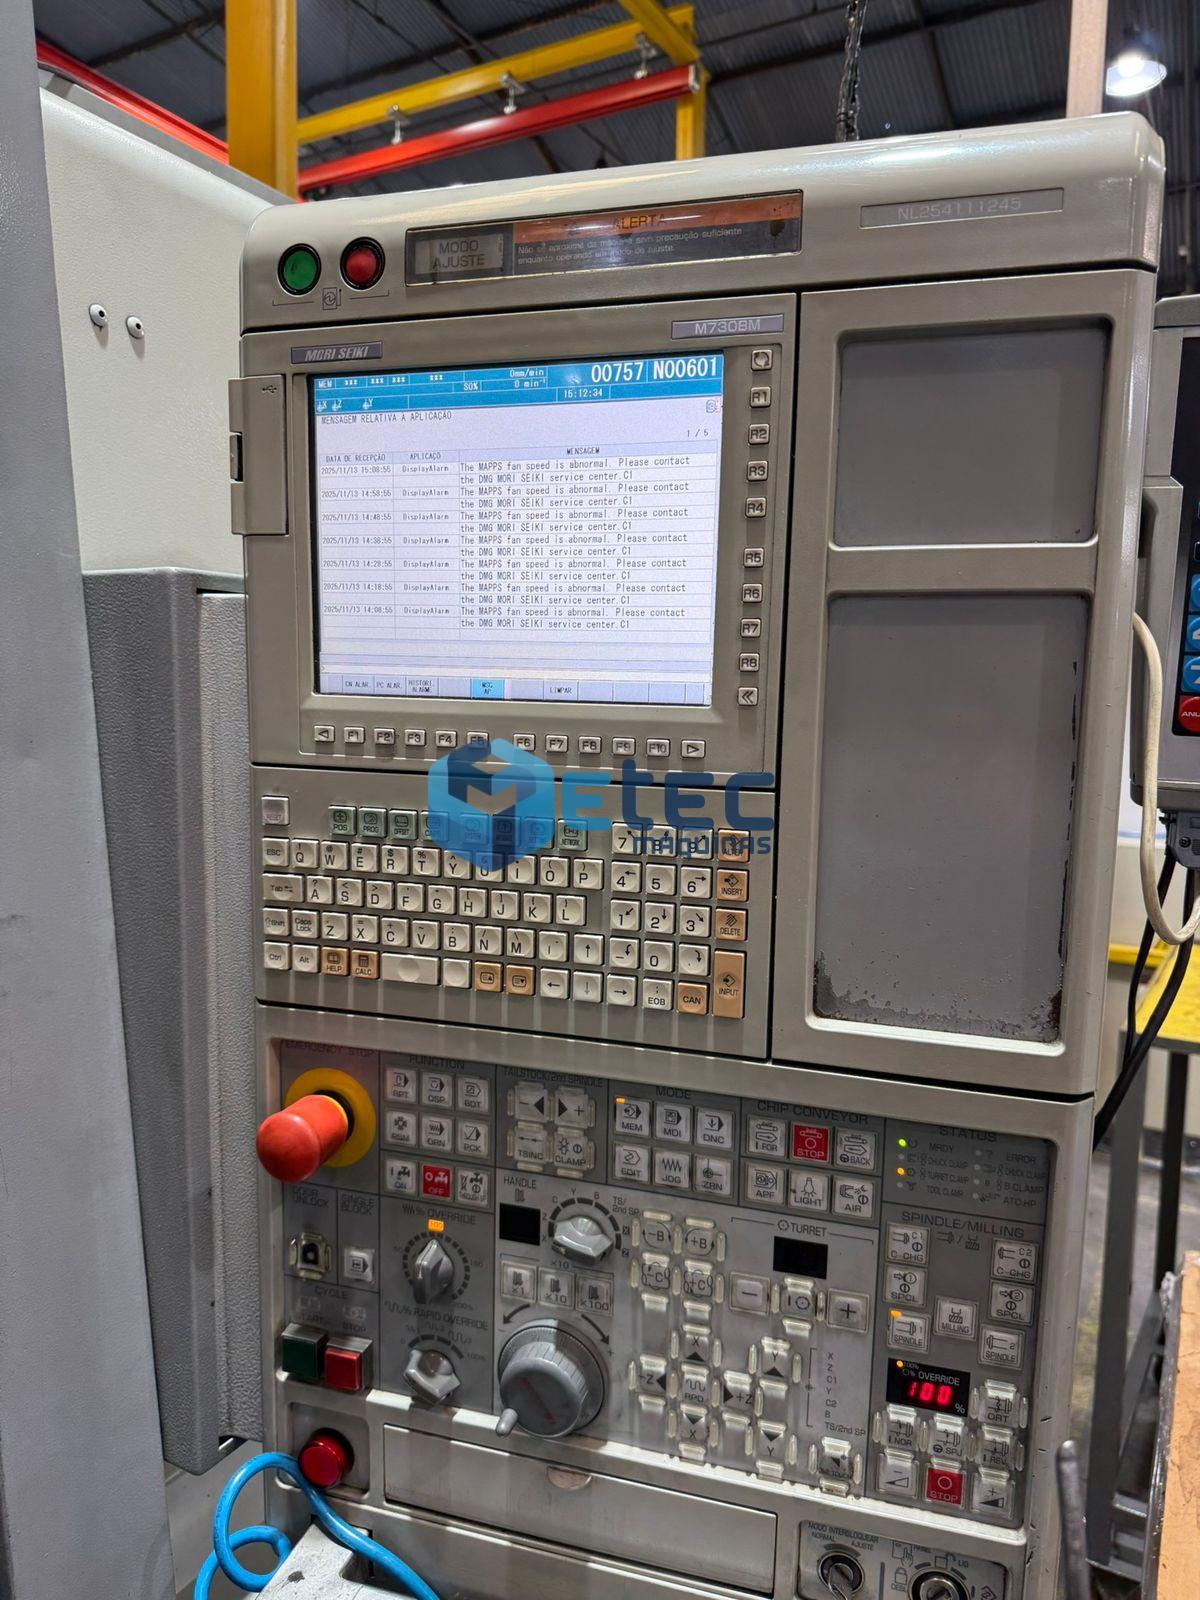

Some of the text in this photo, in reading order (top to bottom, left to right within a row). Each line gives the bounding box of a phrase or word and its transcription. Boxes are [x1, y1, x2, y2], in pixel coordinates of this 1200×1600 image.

[898, 198, 1021, 221] NL254111245
[613, 213, 666, 229] ALERTA
[656, 231, 699, 242] precaução
[439, 240, 479, 254] MODO
[433, 253, 485, 269] AJUSTE
[695, 319, 762, 335] M730BM
[305, 346, 370, 361] MORI SEIKI
[653, 357, 717, 380] N00601
[318, 380, 333, 389] MEM
[563, 389, 603, 399] 15:12:34
[752, 391, 767, 403] R1
[321, 416, 357, 425] MENSAGEM
[361, 413, 397, 423] RELATIVA
[750, 428, 767, 440] R2
[566, 446, 600, 455] MENSAGEM
[326, 455, 342, 464] DATA
[344, 455, 352, 463] DE
[460, 456, 690, 472] The MAPPS fan speed is abnormal. Please contact
[321, 465, 358, 475] 2025/11/13
[402, 464, 449, 474] DisplayAlarm
[749, 465, 766, 477] R3
[460, 475, 475, 484] the
[478, 474, 493, 484] DMG
[497, 474, 516, 483] MORI
[521, 473, 544, 482] SEIKI
[550, 473, 584, 482] service
[747, 502, 764, 513] R4
[745, 552, 762, 563] R5
[743, 588, 760, 600] R6
[324, 605, 360, 614] 2025/11/13
[404, 606, 450, 615] DisplayAlarm
[461, 607, 686, 617] The MAPPS fan speed is abnormal. Please contact
[461, 619, 475, 628] the
[479, 619, 493, 628] DMG
[497, 619, 515, 628] MORI
[520, 619, 543, 628] SEIKI
[549, 620, 582, 629] service
[742, 623, 759, 635] R7
[741, 657, 757, 669] R8
[347, 731, 360, 740] F1
[378, 732, 391, 742] F2
[407, 732, 421, 743] F3
[437, 734, 452, 744] F4
[516, 737, 531, 748] F6
[549, 739, 564, 749] F7
[582, 740, 597, 751] F8
[616, 741, 631, 752] F9
[649, 743, 667, 754] F10
[332, 824, 348, 832] POS
[363, 825, 379, 834] PROG
[266, 849, 281, 857] ESC
[295, 852, 305, 864] Q
[325, 855, 335, 865] W
[355, 857, 364, 868] E
[386, 859, 395, 870] R
[418, 861, 426, 872] T
[579, 872, 588, 884] P
[270, 885, 284, 893] Tab
[651, 878, 661, 890] 5
[687, 880, 696, 893] 6
[310, 889, 320, 900] A
[341, 891, 349, 902] S
[720, 888, 743, 897] INSERT
[371, 894, 379, 905] D
[295, 918, 312, 928] Caps
[295, 923, 313, 933] Lock
[650, 916, 660, 929] 2
[686, 920, 695, 932] 3
[719, 928, 741, 937] DELETE
[269, 953, 282, 961] Ctrl
[299, 956, 309, 964] Alt
[326, 965, 342, 973] HELP
[355, 968, 372, 976] CALC
[718, 988, 740, 997] INPUT
[648, 997, 666, 1006] EOB
[682, 996, 701, 1005] CAN
[409, 1055, 465, 1070] FUNCTION
[655, 1087, 692, 1100] MODE
[757, 1100, 869, 1125] CHIP CONVEYOR
[621, 1122, 643, 1132] MEM
[663, 1127, 682, 1138] MDI
[703, 1134, 725, 1145] DNC
[939, 1126, 998, 1143] STATUS
[761, 1142, 778, 1152] FOR
[797, 1149, 825, 1160] STOP
[555, 1155, 586, 1167] CLAMP
[850, 1156, 871, 1166] BACK
[621, 1167, 641, 1178] EDIT
[504, 1176, 537, 1189] HANDLE
[662, 1175, 682, 1185] JOG
[703, 1182, 723, 1191] ZRN
[794, 1195, 824, 1207] LIGHT
[844, 1203, 862, 1213] AIR
[427, 1208, 477, 1225] OVERRIDE
[791, 1222, 827, 1237] TURRET
[901, 1210, 1025, 1238] SPINDLE/MILLING
[413, 1307, 489, 1330] RAPID OVERRIDE
[941, 1324, 970, 1334] MILLING
[893, 1336, 923, 1347] SPINDLE
[985, 1352, 1016, 1363] SPINDLE
[918, 1370, 961, 1386] OVERRIDE
[907, 1381, 953, 1404] 100
[929, 1490, 959, 1502] STOP
[828, 1526, 879, 1543] INTERBLOQUEAR
[851, 1540, 874, 1551] AJUSTE
